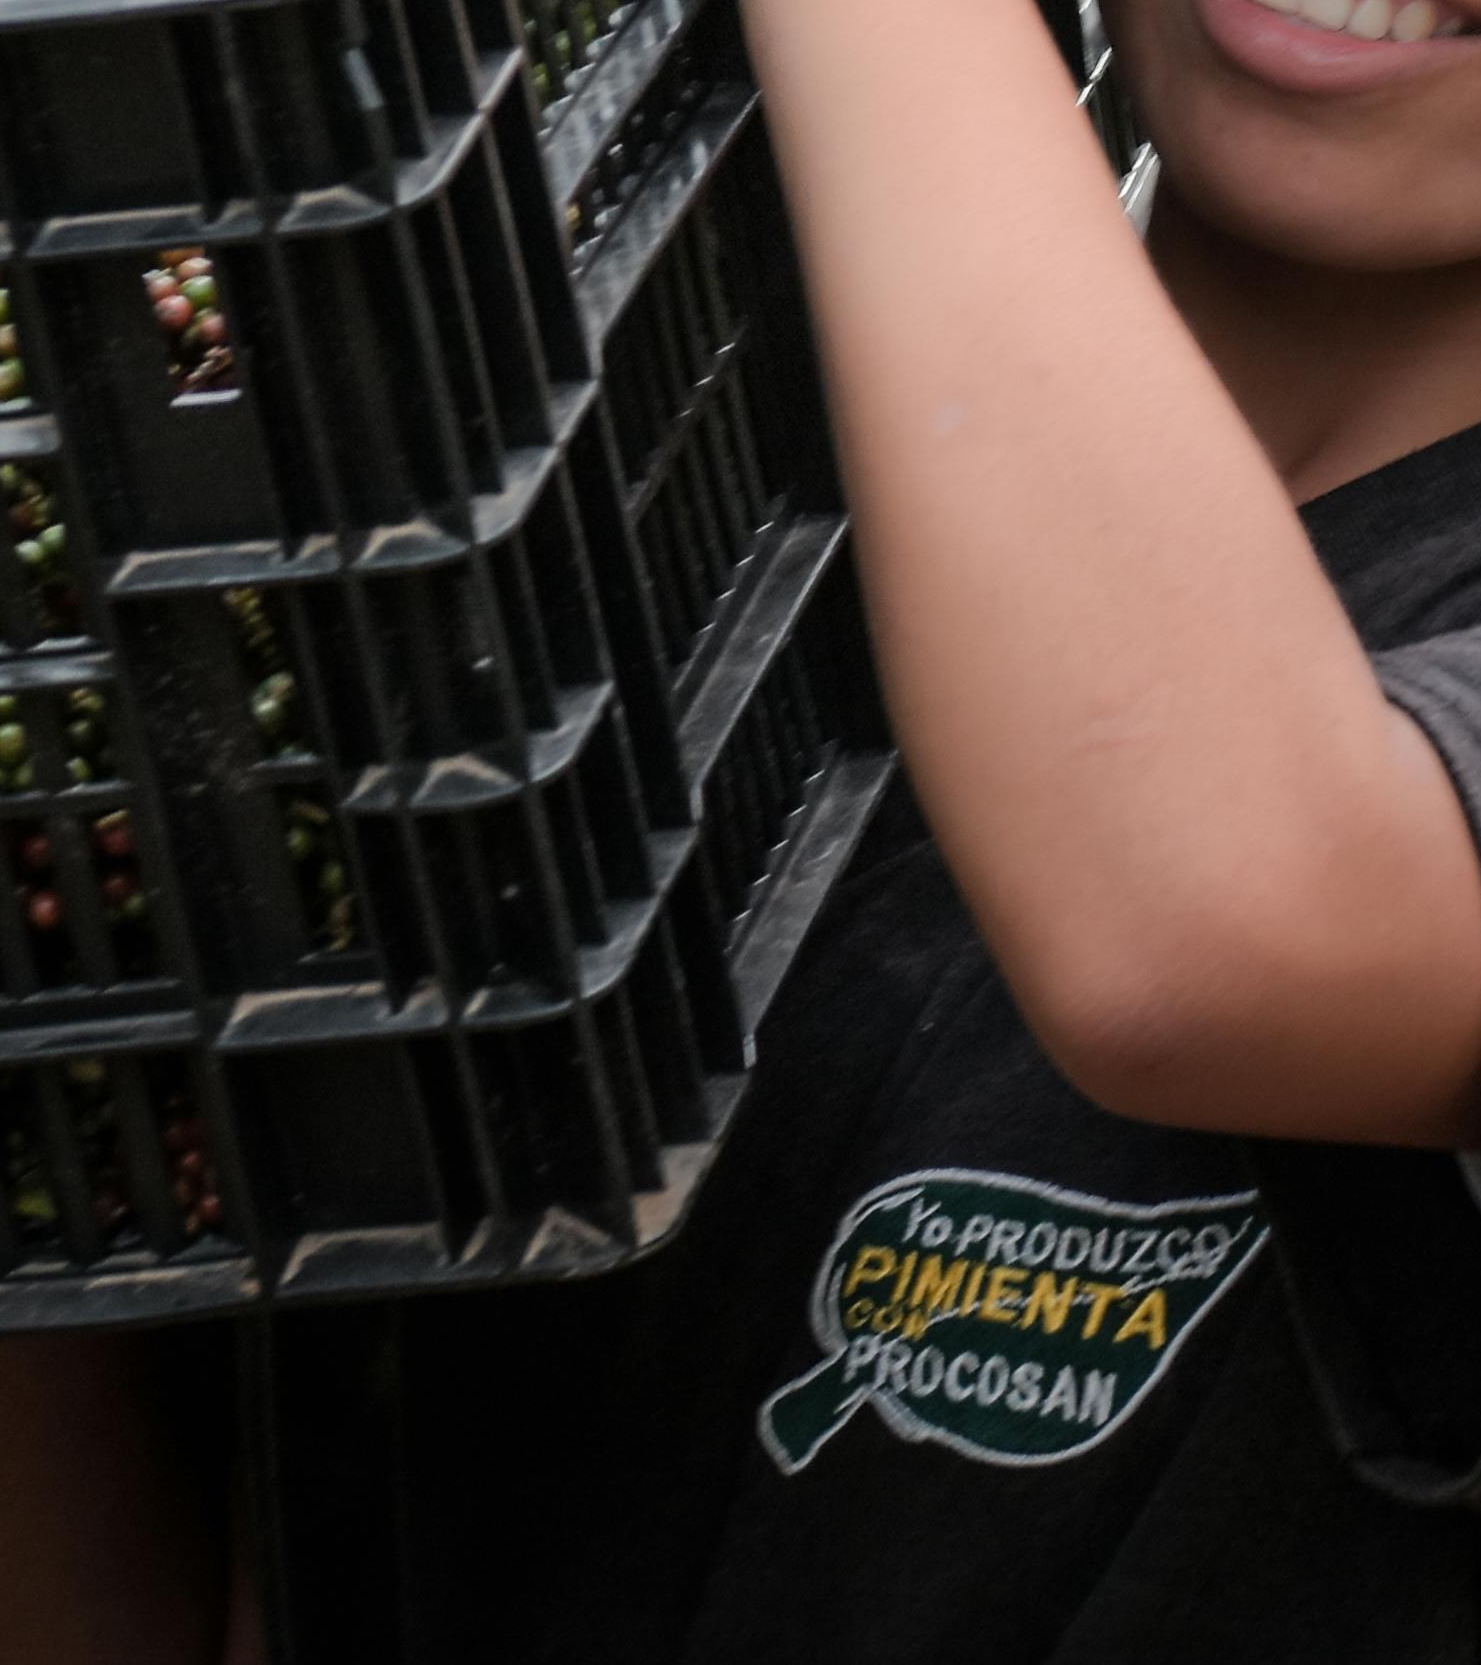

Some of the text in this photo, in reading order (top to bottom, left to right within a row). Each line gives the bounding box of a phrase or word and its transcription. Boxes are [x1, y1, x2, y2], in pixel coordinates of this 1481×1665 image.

[951, 1214, 1231, 1279] PRODUZCO
[843, 1246, 1167, 1351] PIMIENTA
[842, 1332, 1118, 1426] PROCOSAN
